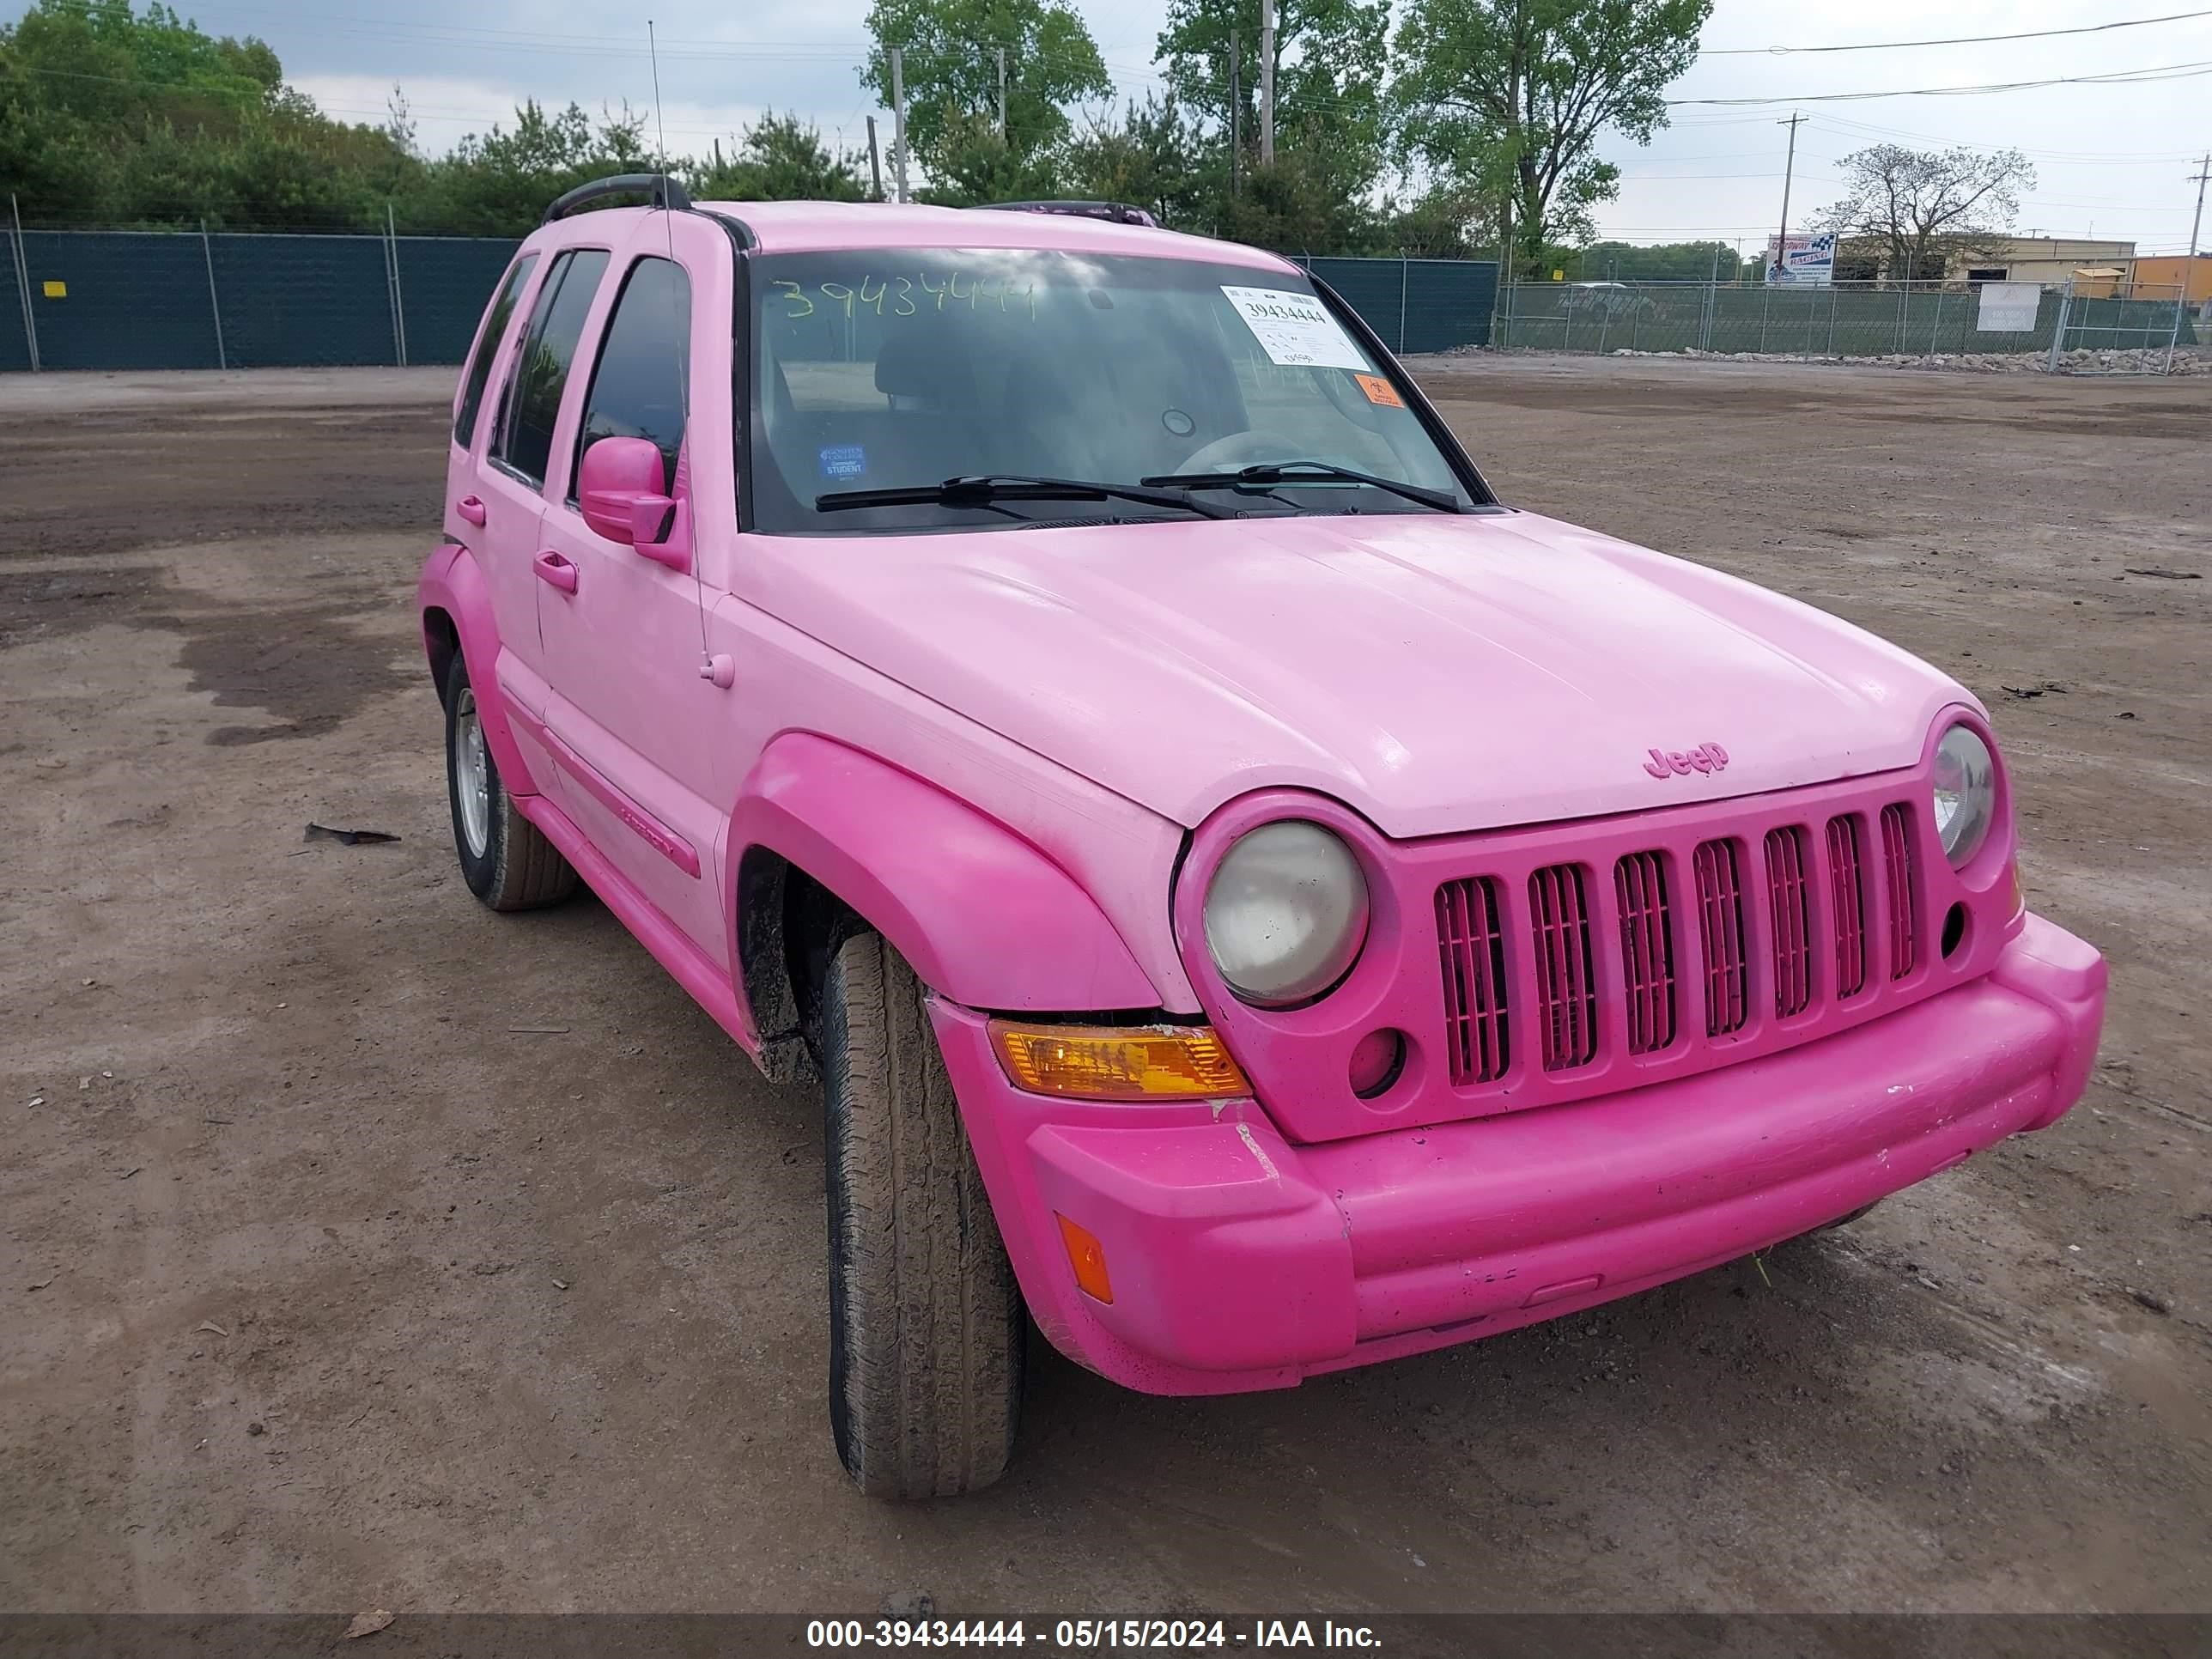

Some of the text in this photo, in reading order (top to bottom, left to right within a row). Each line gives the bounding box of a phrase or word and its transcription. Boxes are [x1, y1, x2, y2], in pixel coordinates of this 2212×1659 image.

[1790, 252, 1828, 265] RACING
[1245, 302, 1327, 325] 39434444
[827, 465, 862, 474] STUDENT
[1643, 742, 1729, 779] Jeep
